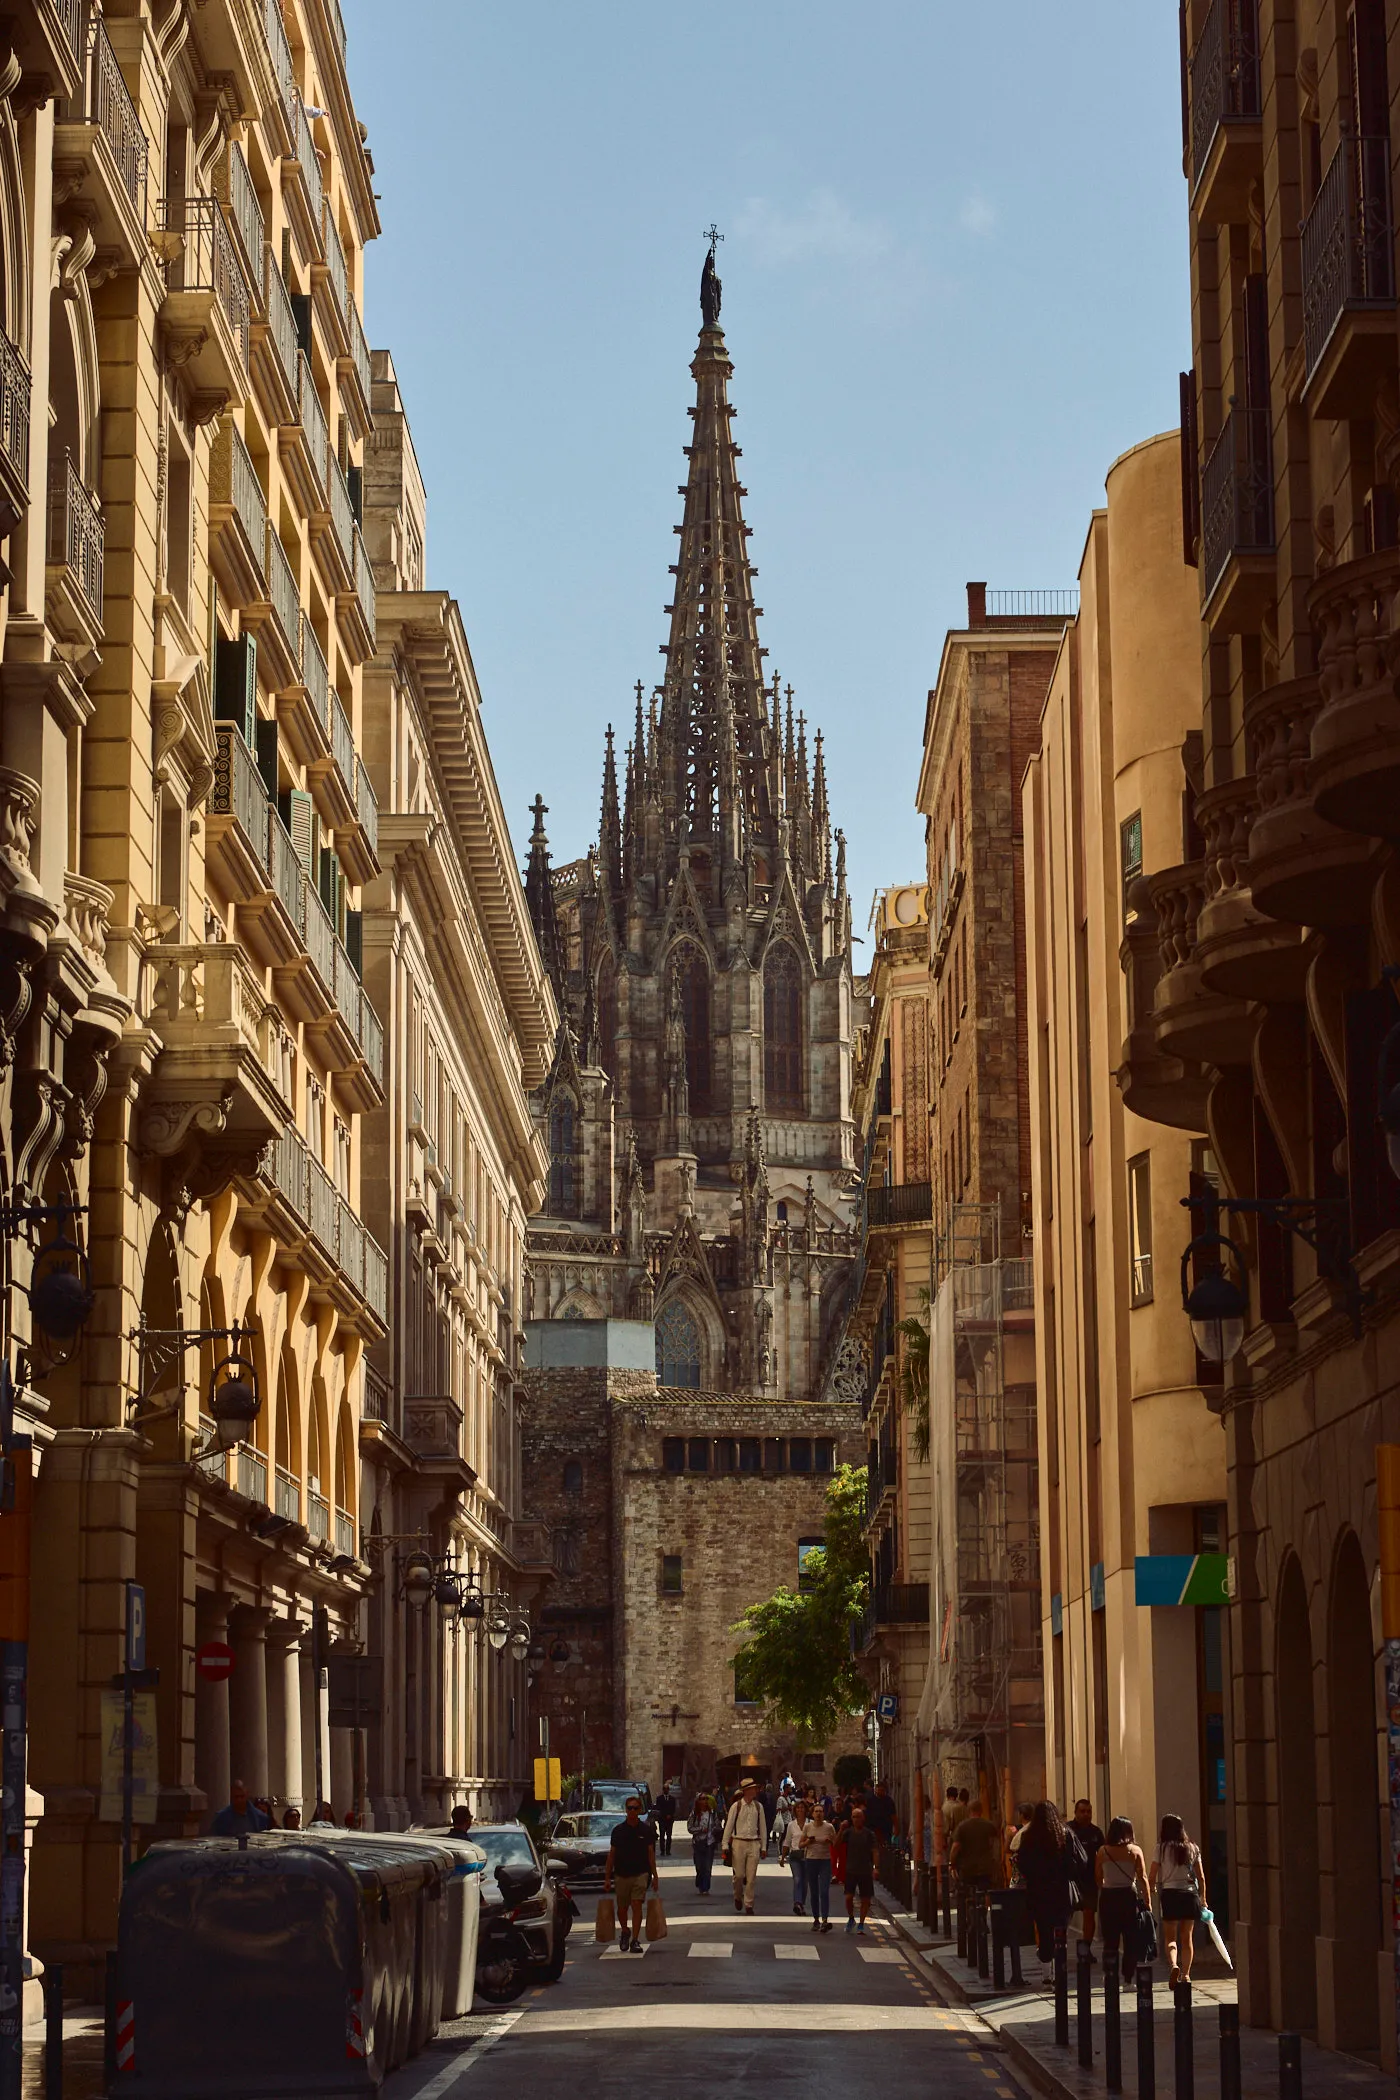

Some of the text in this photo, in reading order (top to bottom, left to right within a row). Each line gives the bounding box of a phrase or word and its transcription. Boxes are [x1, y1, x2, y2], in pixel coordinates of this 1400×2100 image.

[888, 887, 929, 928] C
[132, 1596, 142, 1660] P
[881, 1697, 893, 1713] P
